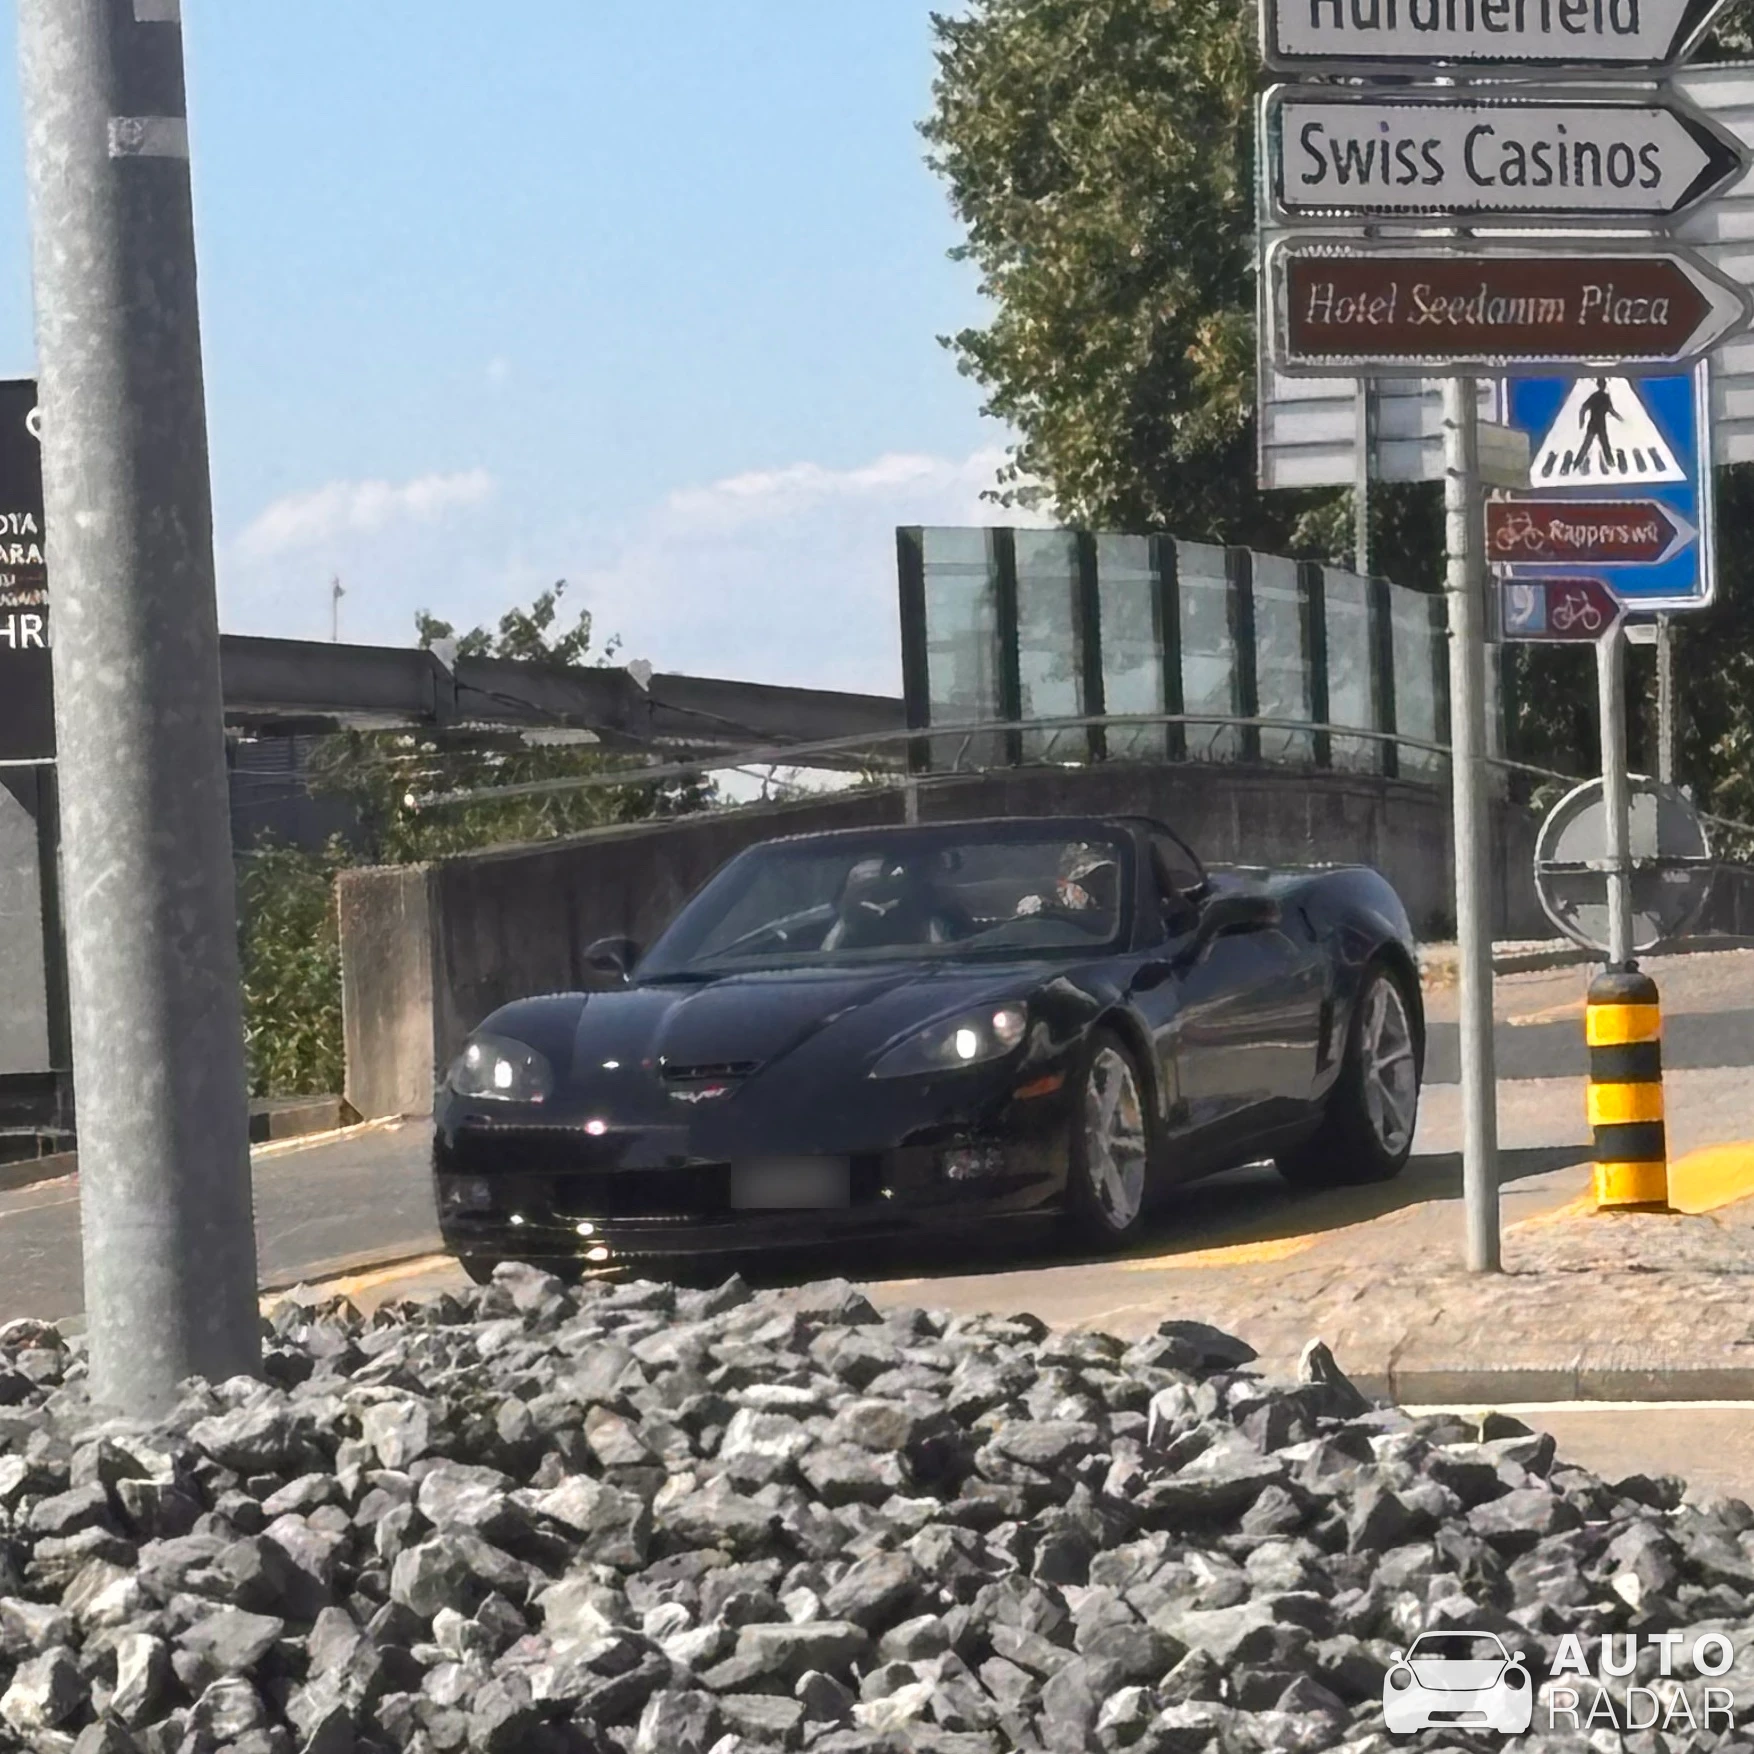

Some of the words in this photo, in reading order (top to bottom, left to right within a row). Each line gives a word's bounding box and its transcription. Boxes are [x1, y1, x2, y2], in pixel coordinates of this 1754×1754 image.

[1300, 121, 1445, 186] Swiss
[1464, 123, 1662, 188] Casinos
[1305, 281, 1397, 324] Hotel
[1406, 282, 1565, 325] Seedamm
[1577, 283, 1670, 326] Plaza
